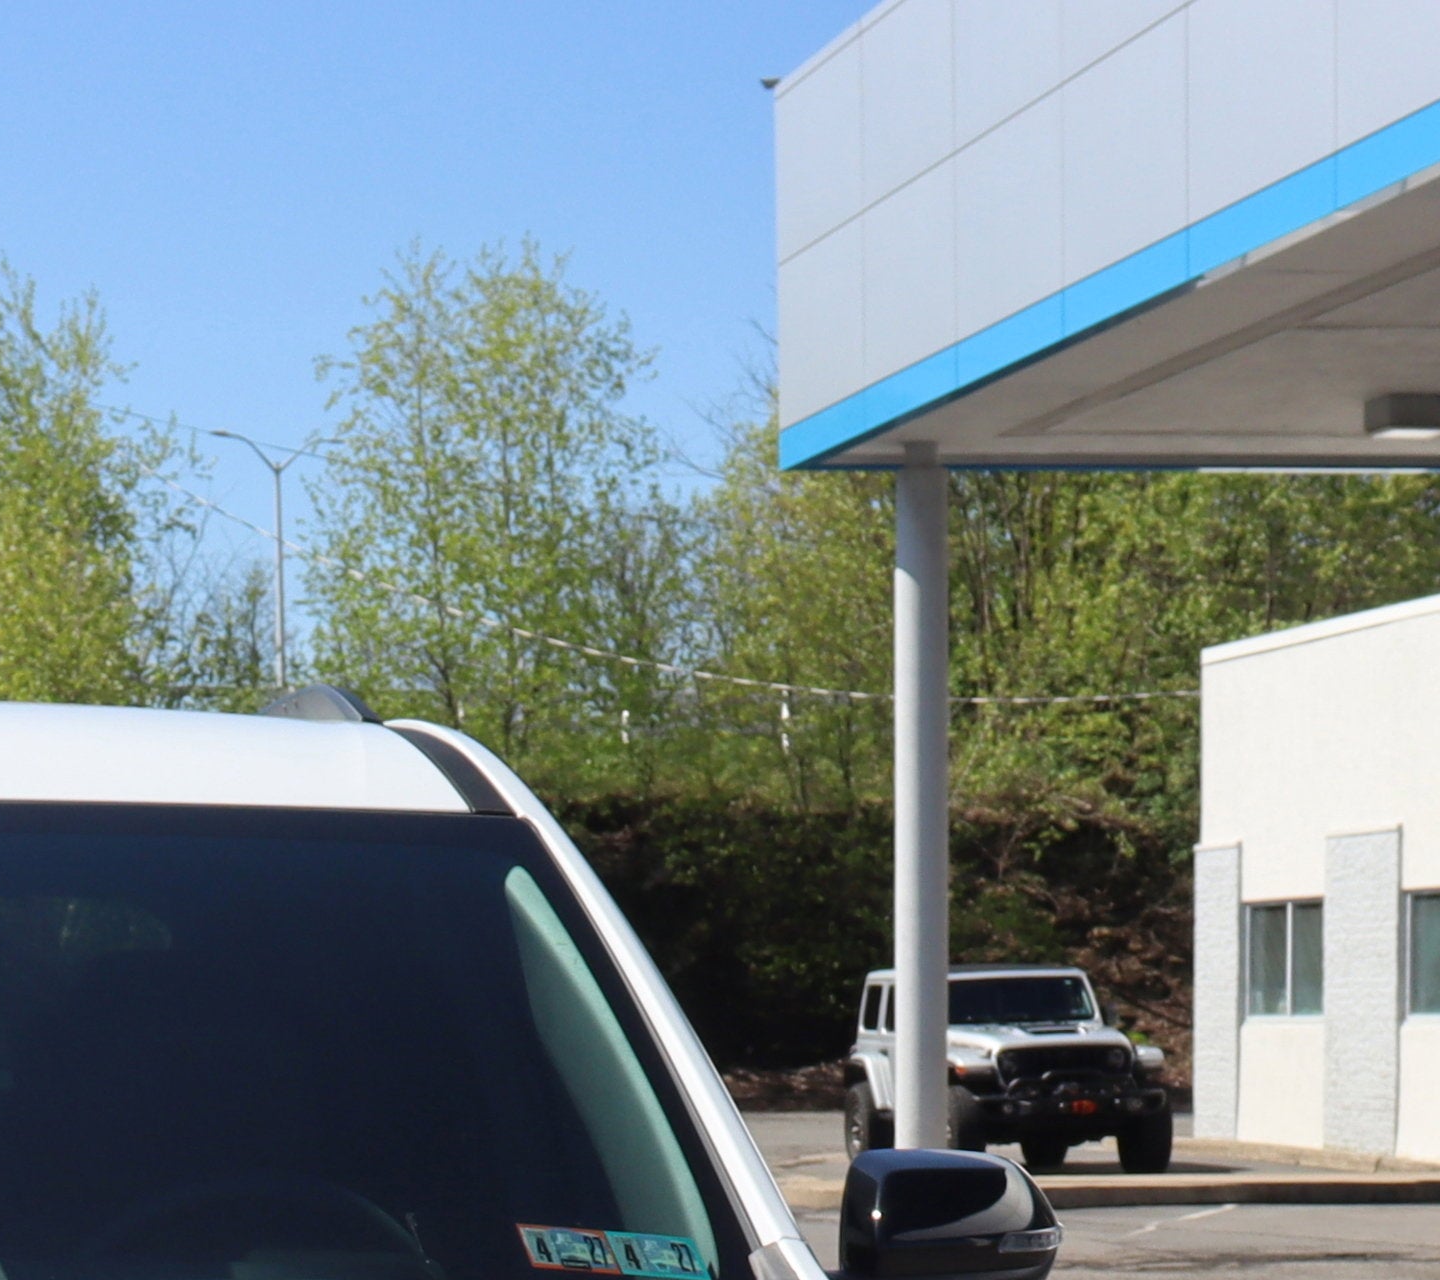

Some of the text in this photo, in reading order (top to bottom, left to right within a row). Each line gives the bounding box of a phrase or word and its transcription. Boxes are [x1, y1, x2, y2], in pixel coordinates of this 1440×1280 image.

[536, 1235, 608, 1267] 4 27
[624, 1242, 696, 1272] 4 27
